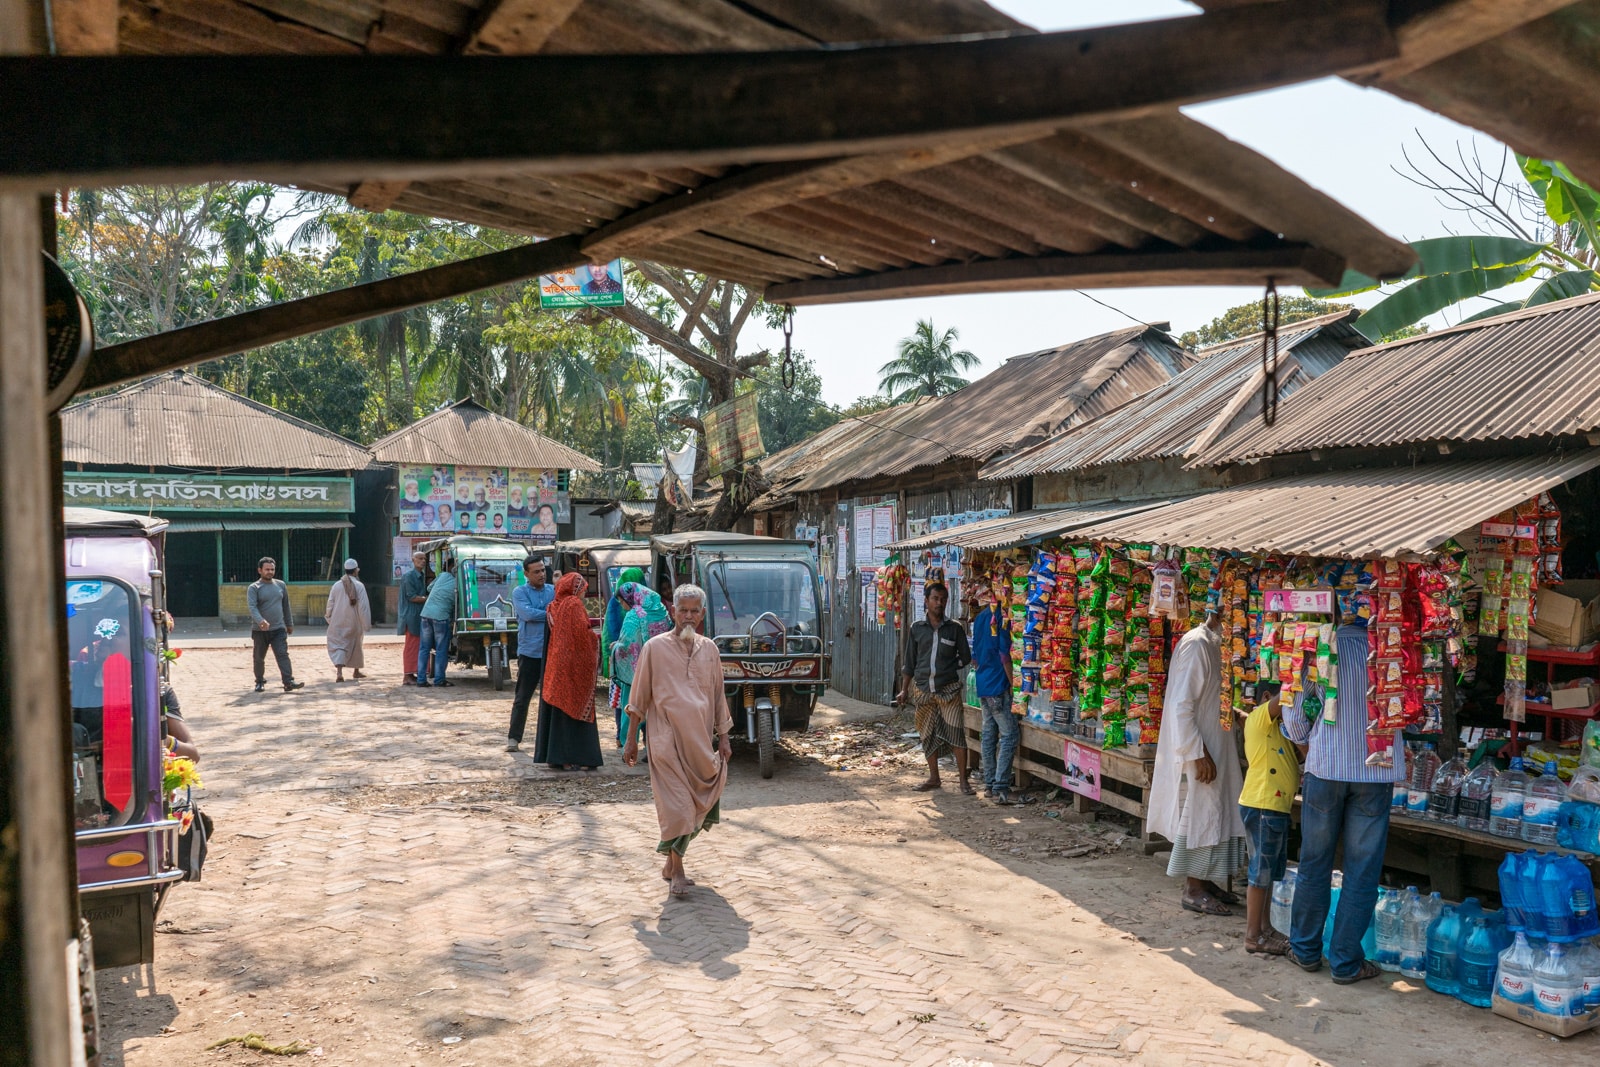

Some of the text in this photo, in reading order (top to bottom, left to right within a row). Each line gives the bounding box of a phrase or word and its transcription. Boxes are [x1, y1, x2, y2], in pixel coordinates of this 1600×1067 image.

[140, 480, 224, 500] মতিন
[1502, 976, 1524, 990] Fresh
[1539, 990, 1562, 1002] Fresh
